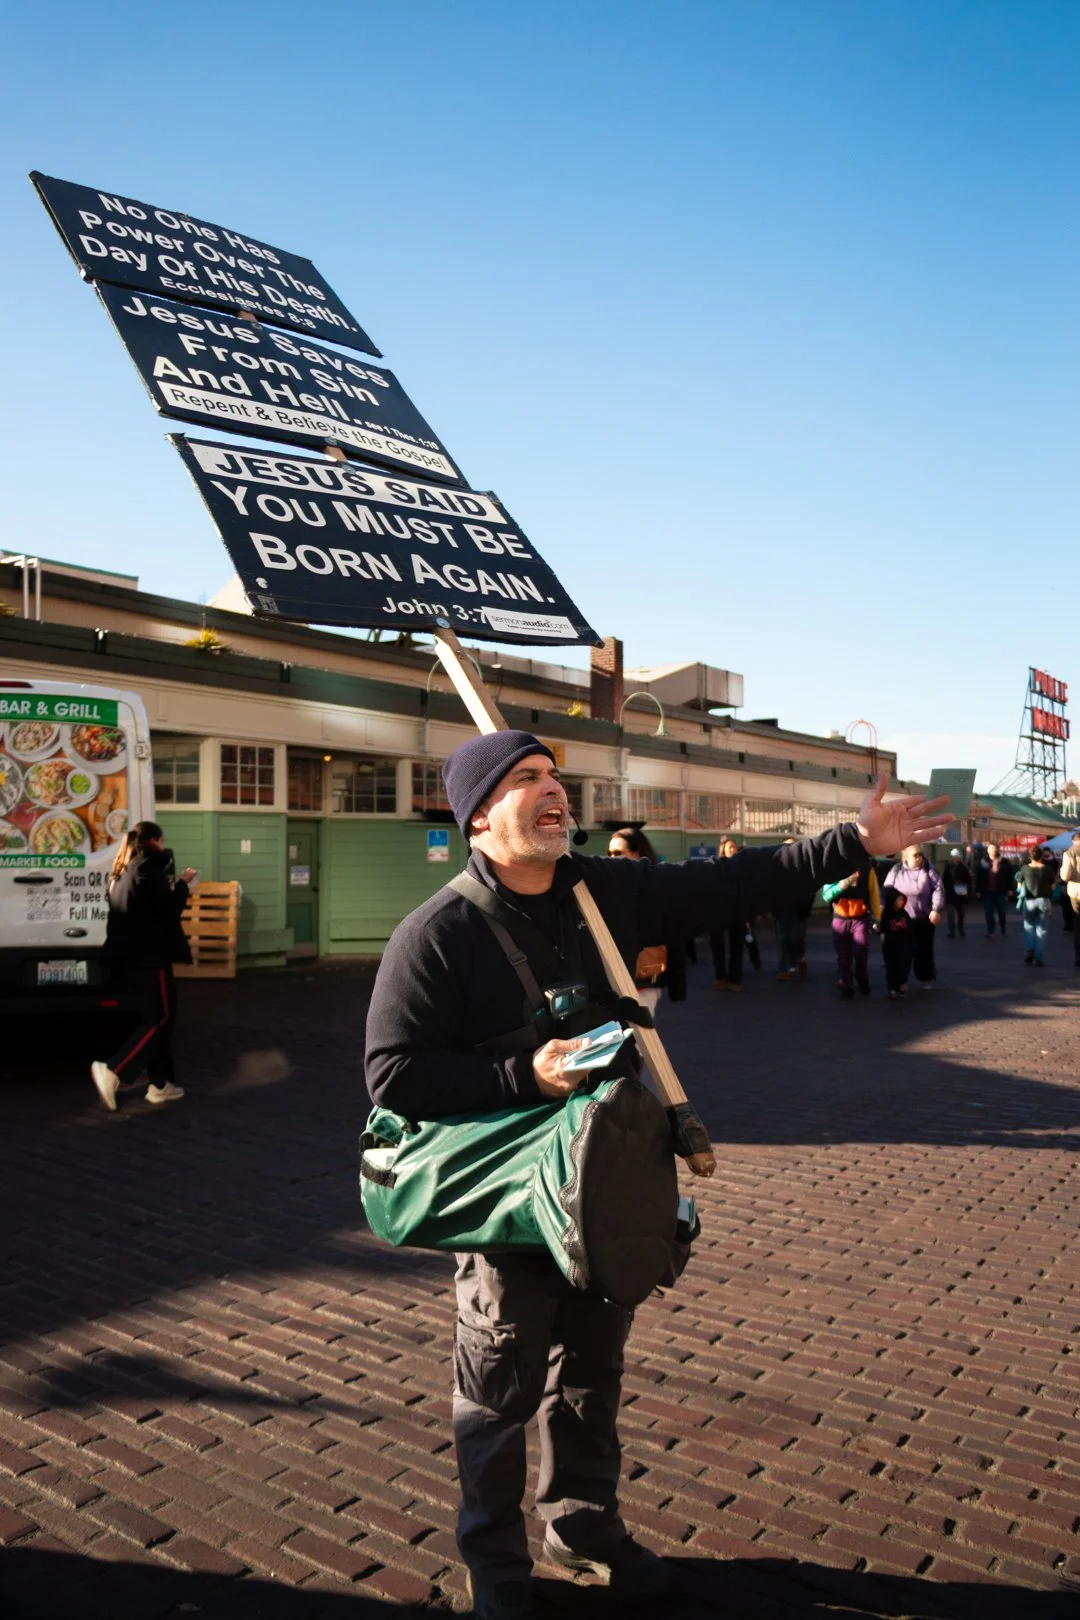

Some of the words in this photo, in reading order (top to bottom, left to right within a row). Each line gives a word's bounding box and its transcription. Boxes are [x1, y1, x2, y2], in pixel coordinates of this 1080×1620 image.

[78, 210, 184, 253] Power
[193, 242, 265, 278] Over
[268, 267, 326, 301] The
[98, 193, 148, 221] No
[153, 210, 219, 242] One
[226, 231, 281, 265] Has
[78, 234, 148, 272] Day
[157, 254, 199, 280] Of
[202, 265, 259, 296] His
[262, 284, 359, 332] Death.
[159, 276, 285, 319] Ecclesiastes
[288, 313, 317, 329] 8:8
[122, 296, 260, 344] Jesus
[268, 331, 391, 388] Saves
[178, 333, 303, 380] From
[311, 369, 380, 407] Sin
[152, 356, 253, 397] And
[170, 388, 250, 418] Repent
[256, 405, 273, 422] &
[276, 410, 350, 440] Believe
[352, 430, 382, 449] the
[385, 441, 447, 470] Gospel
[215, 452, 375, 497] JESUS
[387, 483, 488, 518] SAID
[210, 480, 327, 528] YOU
[335, 501, 459, 548] MUST
[463, 523, 533, 560] BE
[249, 532, 403, 583] BORN
[410, 554, 556, 604] AGAIN.
[382, 596, 450, 618] John
[453, 603, 488, 624] 3:7
[0, 699, 31, 715] BAR
[36, 701, 49, 715] &
[54, 701, 101, 719] GRILL
[45, 857, 79, 867] FOOD
[64, 871, 86, 887] Scan
[88, 872, 102, 888] QR
[69, 907, 88, 920] Full
[71, 891, 81, 902] to
[84, 893, 101, 902] see
